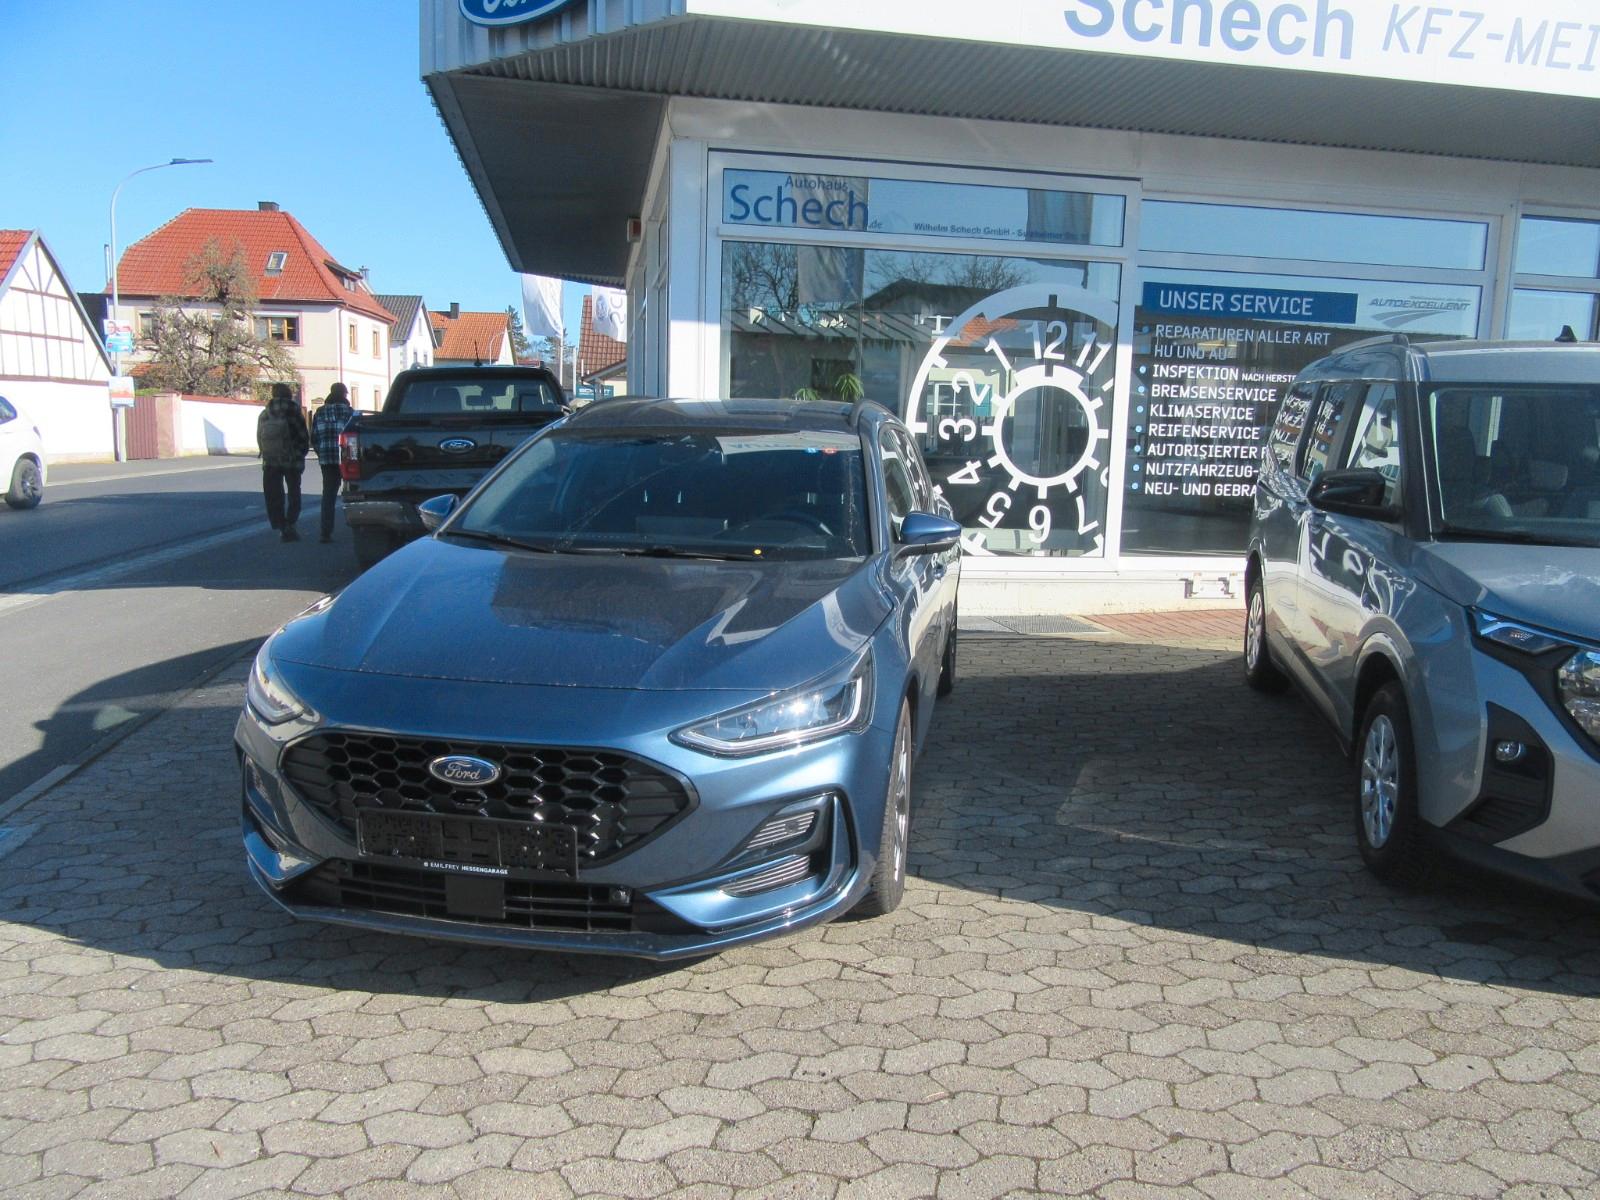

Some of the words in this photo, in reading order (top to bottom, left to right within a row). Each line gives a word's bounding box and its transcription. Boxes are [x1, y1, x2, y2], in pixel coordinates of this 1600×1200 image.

[1064, 0, 1354, 59] Schech
[785, 176, 849, 192] Autohaus
[729, 179, 869, 231] Schech
[914, 223, 948, 232] Wilhelm
[950, 225, 981, 234] Schech
[983, 227, 1010, 236] GmbH
[1159, 290, 1224, 311] UNSER
[1230, 295, 1313, 315] SERVICE
[1025, 320, 1068, 360] 12
[1156, 324, 1254, 342] REPARATUREN
[1257, 330, 1301, 345] ALLER
[1303, 333, 1331, 345] ART
[1154, 345, 1173, 358] HU
[1177, 346, 1204, 360] UND
[1152, 364, 1239, 381] INSPEKTION
[1242, 372, 1264, 382] NACH
[1151, 384, 1277, 402] BREMSENSERVICE
[1150, 404, 1254, 420] KLIMASERVICE
[1149, 423, 1260, 440] REIFENSERVICE
[1147, 443, 1257, 459] AUTORISIERTER
[1146, 463, 1259, 478] NUTZFAHRZEUG-
[1145, 482, 1179, 495] NEU-
[1182, 483, 1210, 496] UND
[444, 761, 481, 780] Ford
